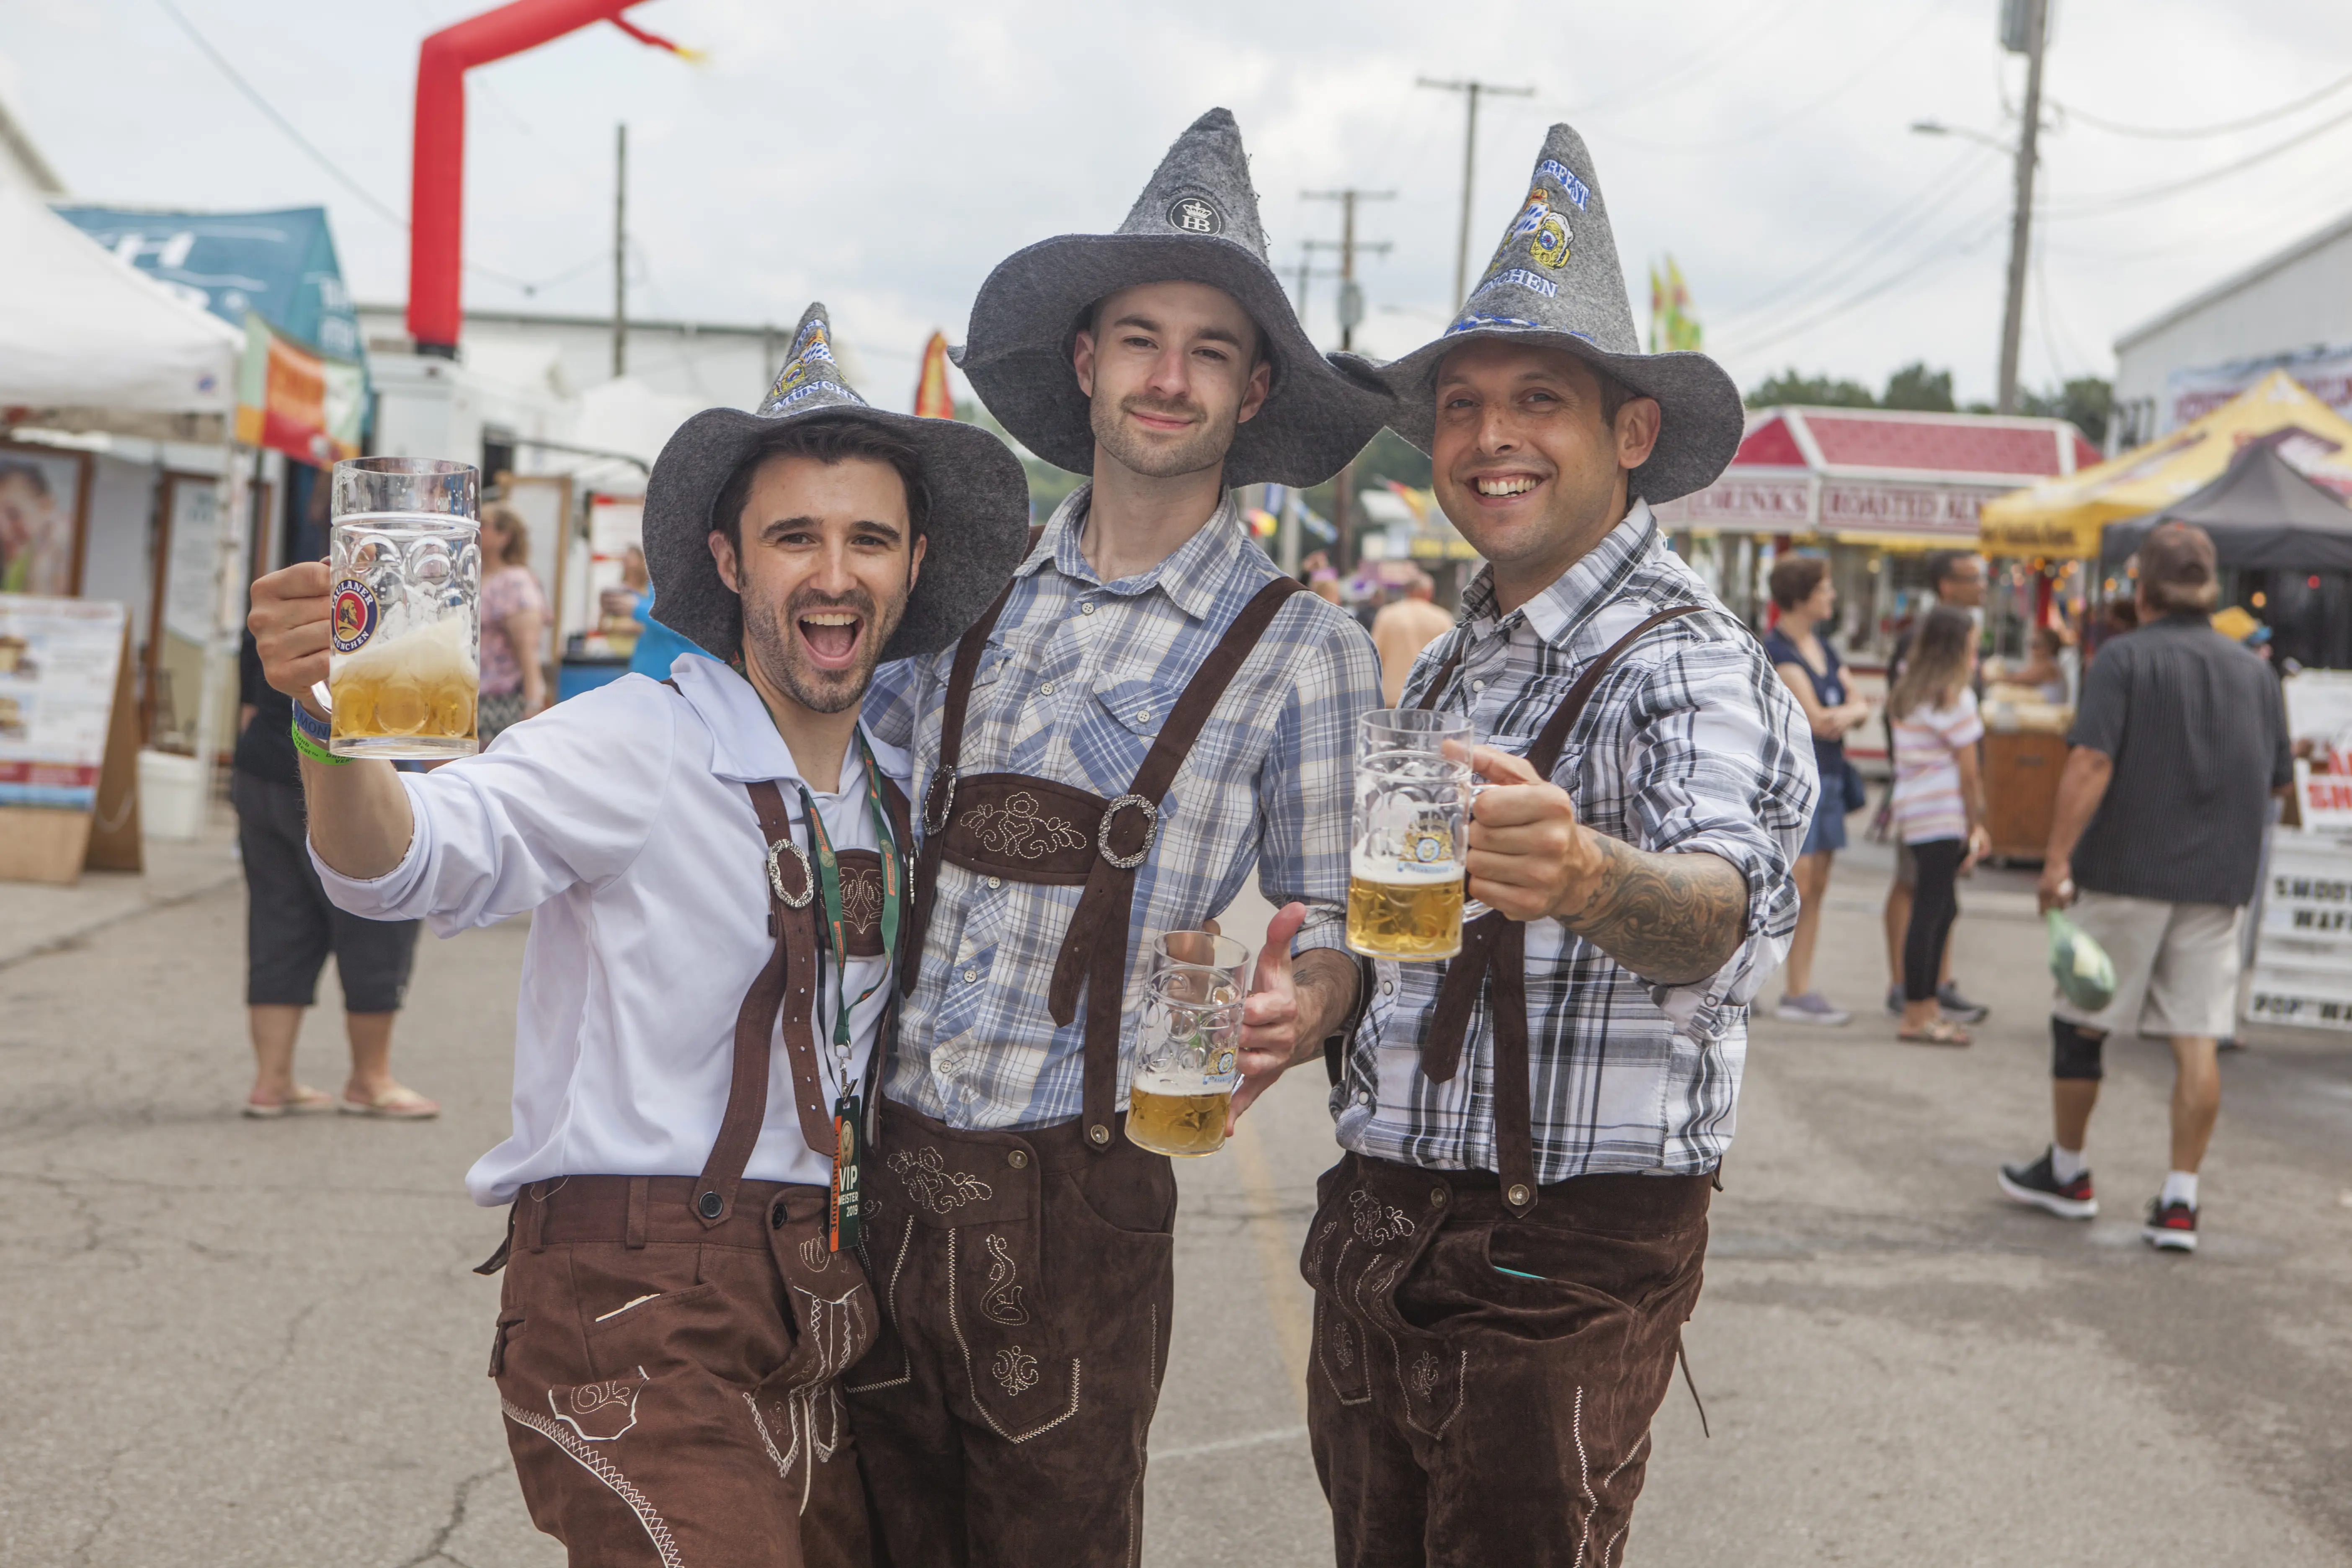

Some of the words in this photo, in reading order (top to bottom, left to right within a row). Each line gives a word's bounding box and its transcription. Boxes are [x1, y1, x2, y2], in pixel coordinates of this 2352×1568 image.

[1181, 215, 1210, 232] HB
[333, 630, 369, 650] MÜNCHEN
[839, 1165, 858, 1192] VIP
[838, 1191, 859, 1206] MEISTER
[846, 1204, 858, 1217] 2019
